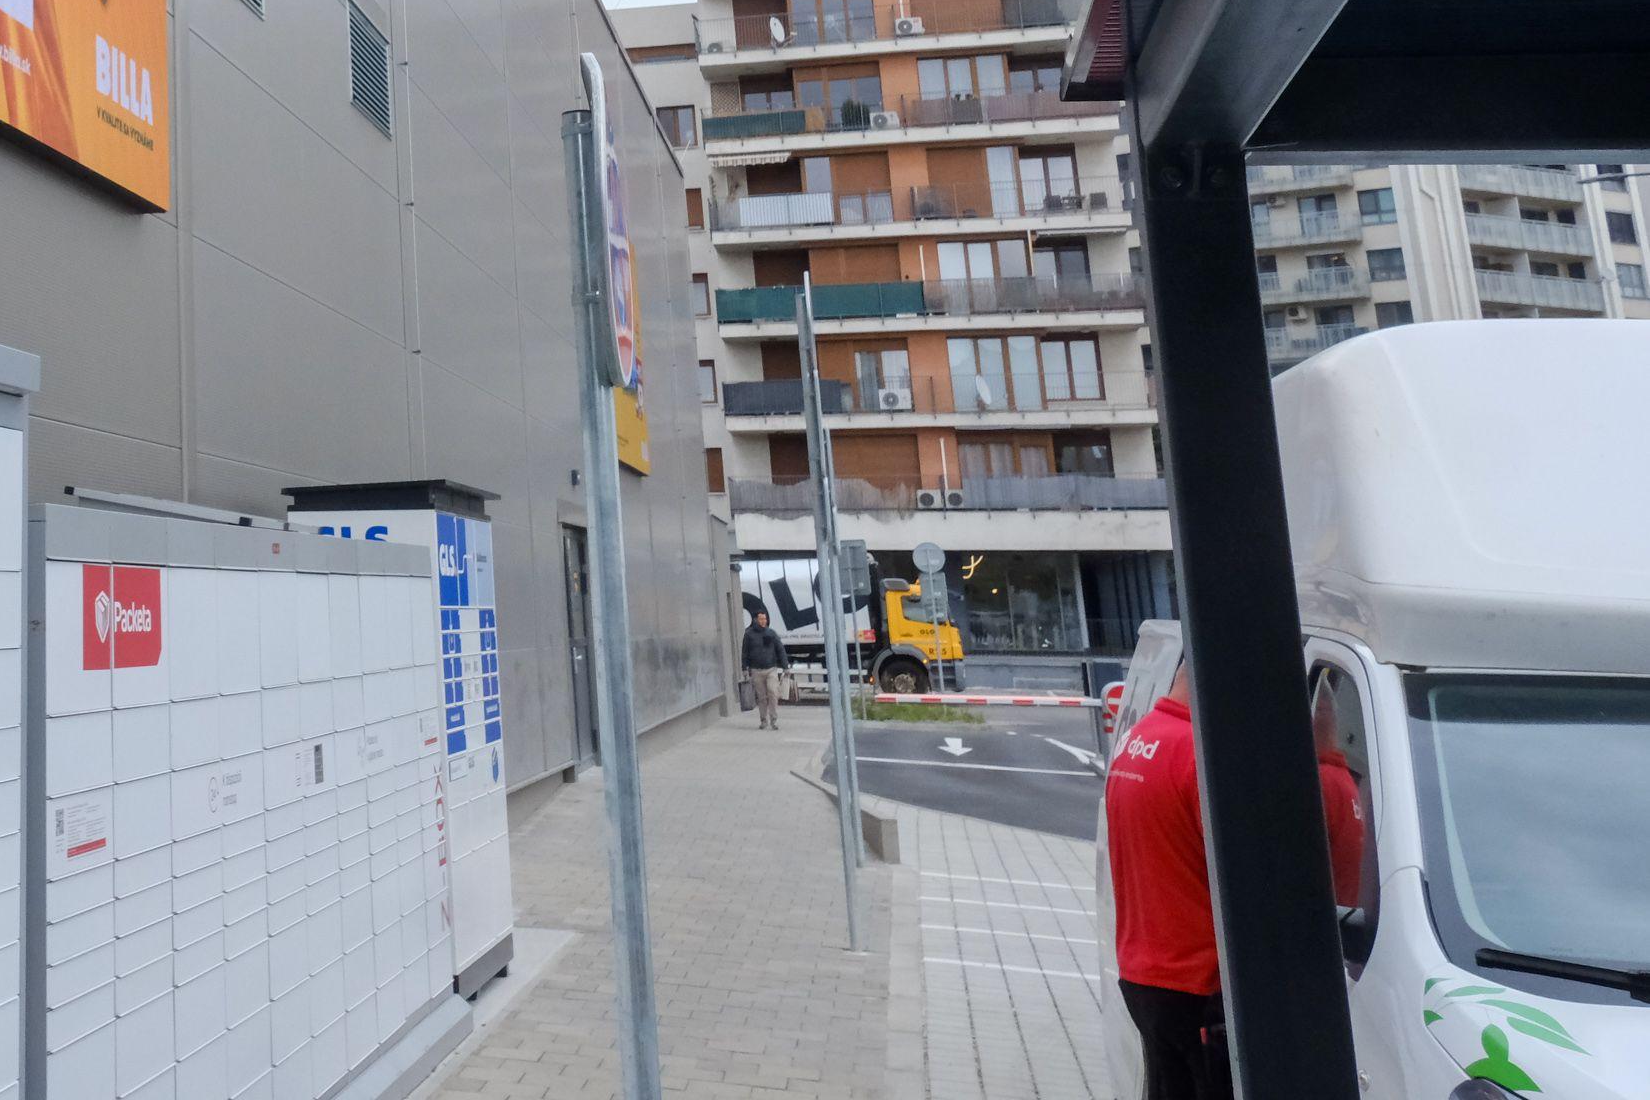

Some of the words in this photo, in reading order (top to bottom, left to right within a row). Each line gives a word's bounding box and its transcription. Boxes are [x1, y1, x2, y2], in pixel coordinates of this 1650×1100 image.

[95, 34, 154, 127] BILLA
[439, 543, 456, 577] GLS
[114, 601, 152, 633] Packeta
[1128, 734, 1160, 760] dpd
